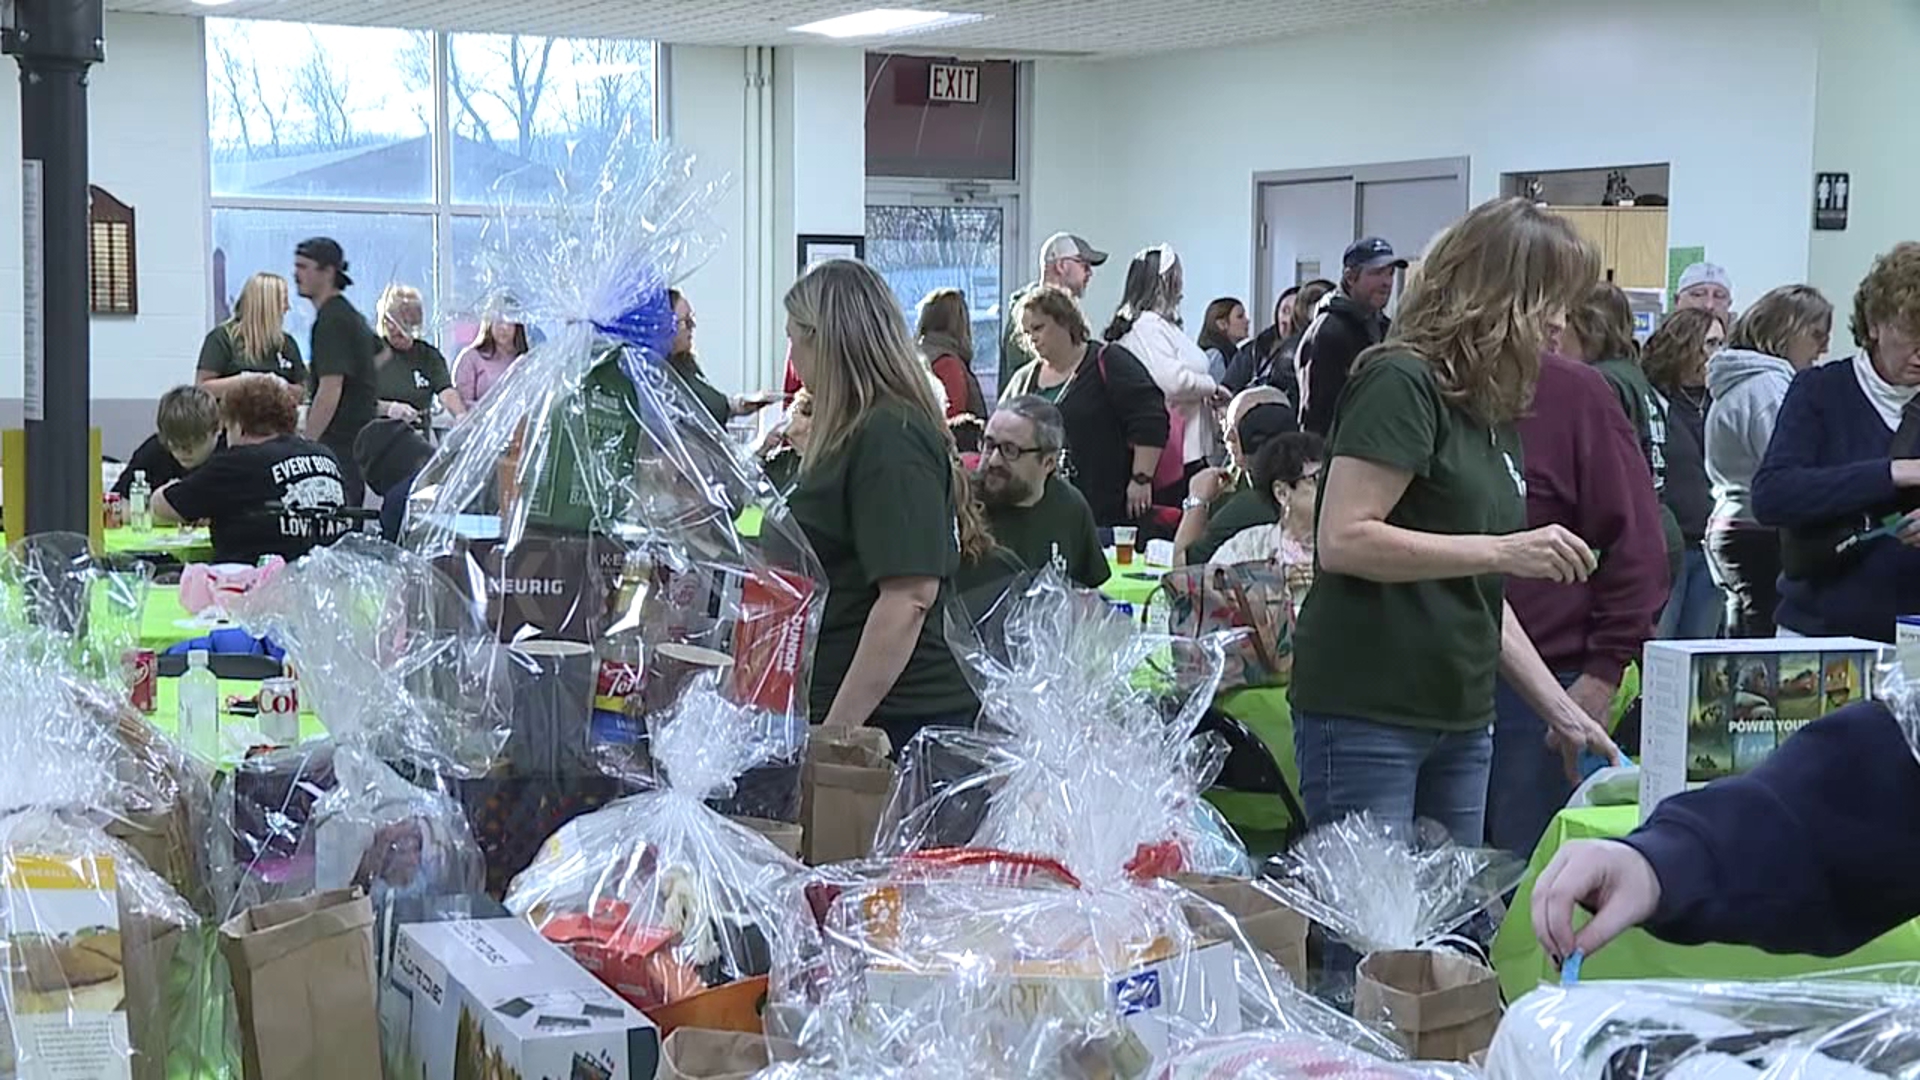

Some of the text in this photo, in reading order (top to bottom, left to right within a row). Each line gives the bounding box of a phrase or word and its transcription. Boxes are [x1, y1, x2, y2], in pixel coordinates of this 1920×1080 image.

[933, 67, 975, 99] EXIT
[272, 456, 313, 485] EVERY
[488, 578, 564, 595] KEURIG
[1728, 720, 1774, 734] POWER
